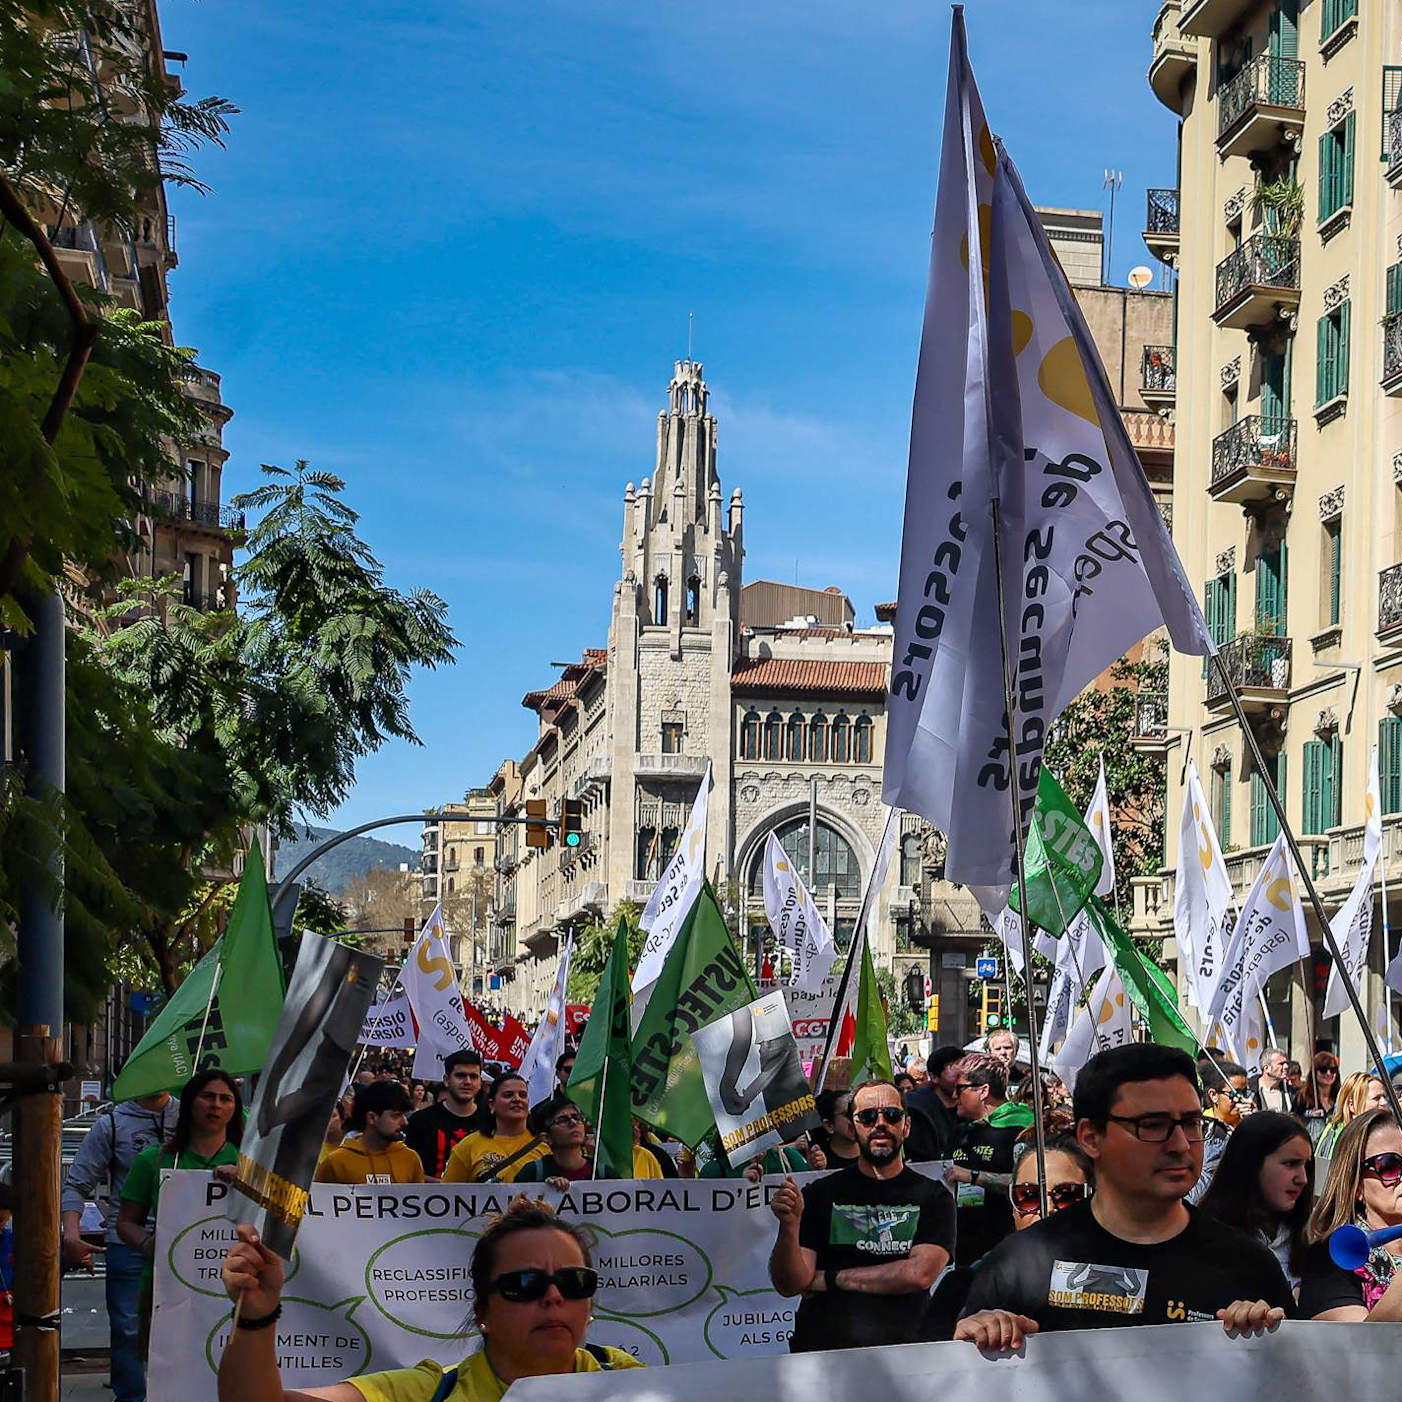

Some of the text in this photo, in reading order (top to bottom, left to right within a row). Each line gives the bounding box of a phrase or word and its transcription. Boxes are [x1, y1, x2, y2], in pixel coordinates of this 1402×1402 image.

[333, 1194, 513, 1219] PERSONA
[540, 1190, 700, 1216] ABORAL
[599, 1254, 685, 1268] MILLORES
[597, 1273, 688, 1289] SALARIALS
[384, 1288, 476, 1302] PROFESSIO
[335, 1336, 360, 1350] DE
[740, 1331, 771, 1345] ALS
